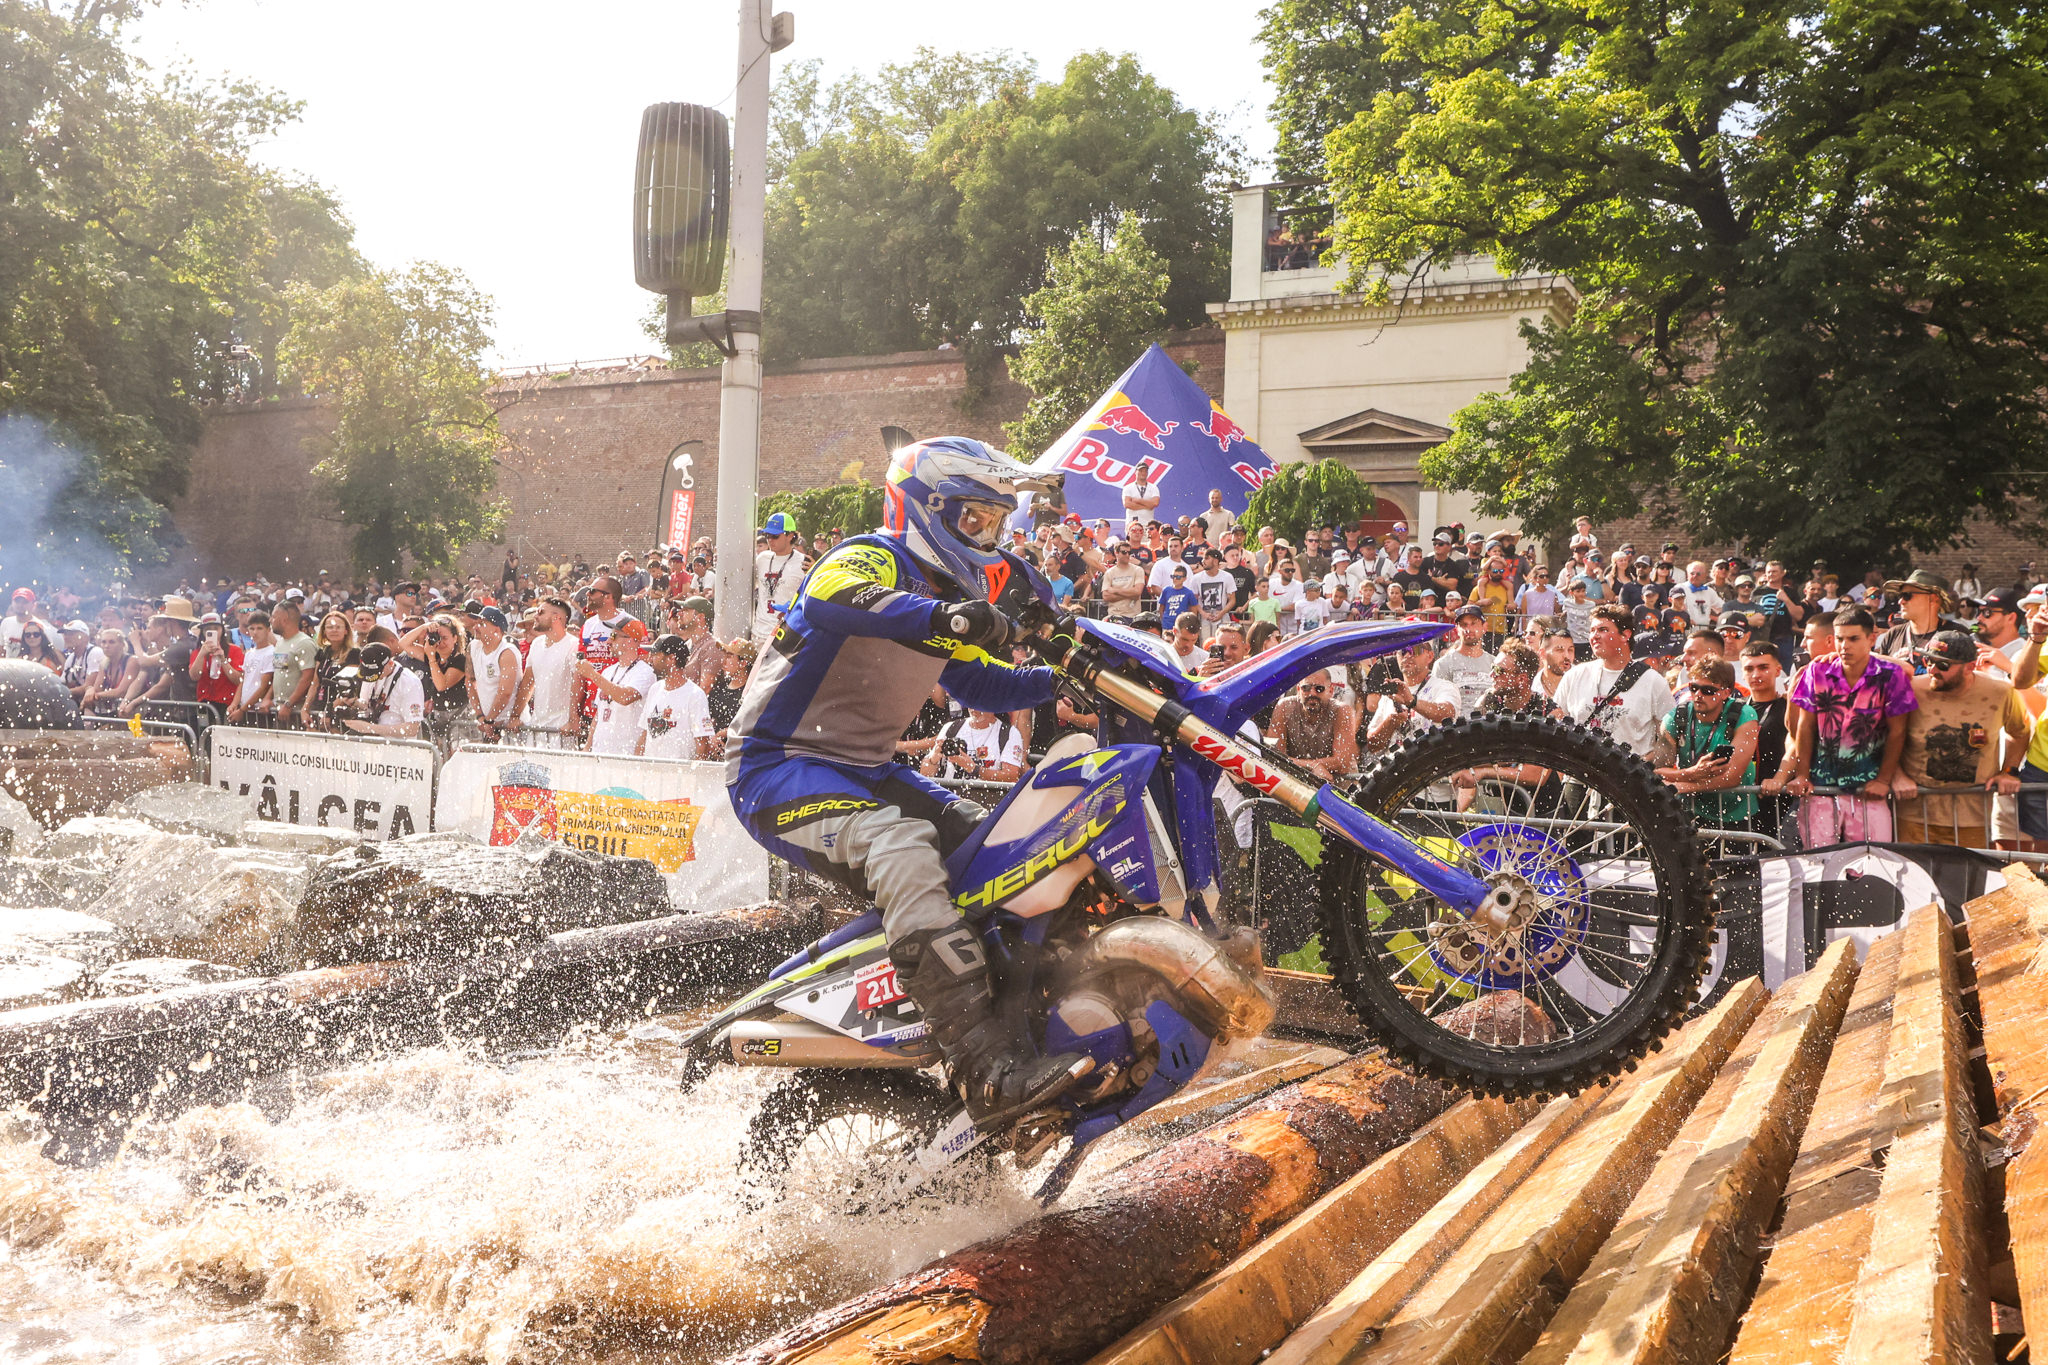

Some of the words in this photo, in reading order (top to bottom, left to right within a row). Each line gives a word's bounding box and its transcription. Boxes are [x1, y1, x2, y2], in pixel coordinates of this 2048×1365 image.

[218, 745, 233, 758] CU
[235, 747, 290, 765] SPRIJINUL
[292, 753, 361, 774] CONSILIULUI
[1190, 735, 1283, 796] KYB
[1084, 773, 1122, 803] SHERCO
[219, 775, 416, 842] ÂLCEA
[678, 812, 693, 824] DE
[776, 800, 878, 826] SHERCO
[951, 800, 1127, 917] HERCO
[822, 986, 831, 996] K.
